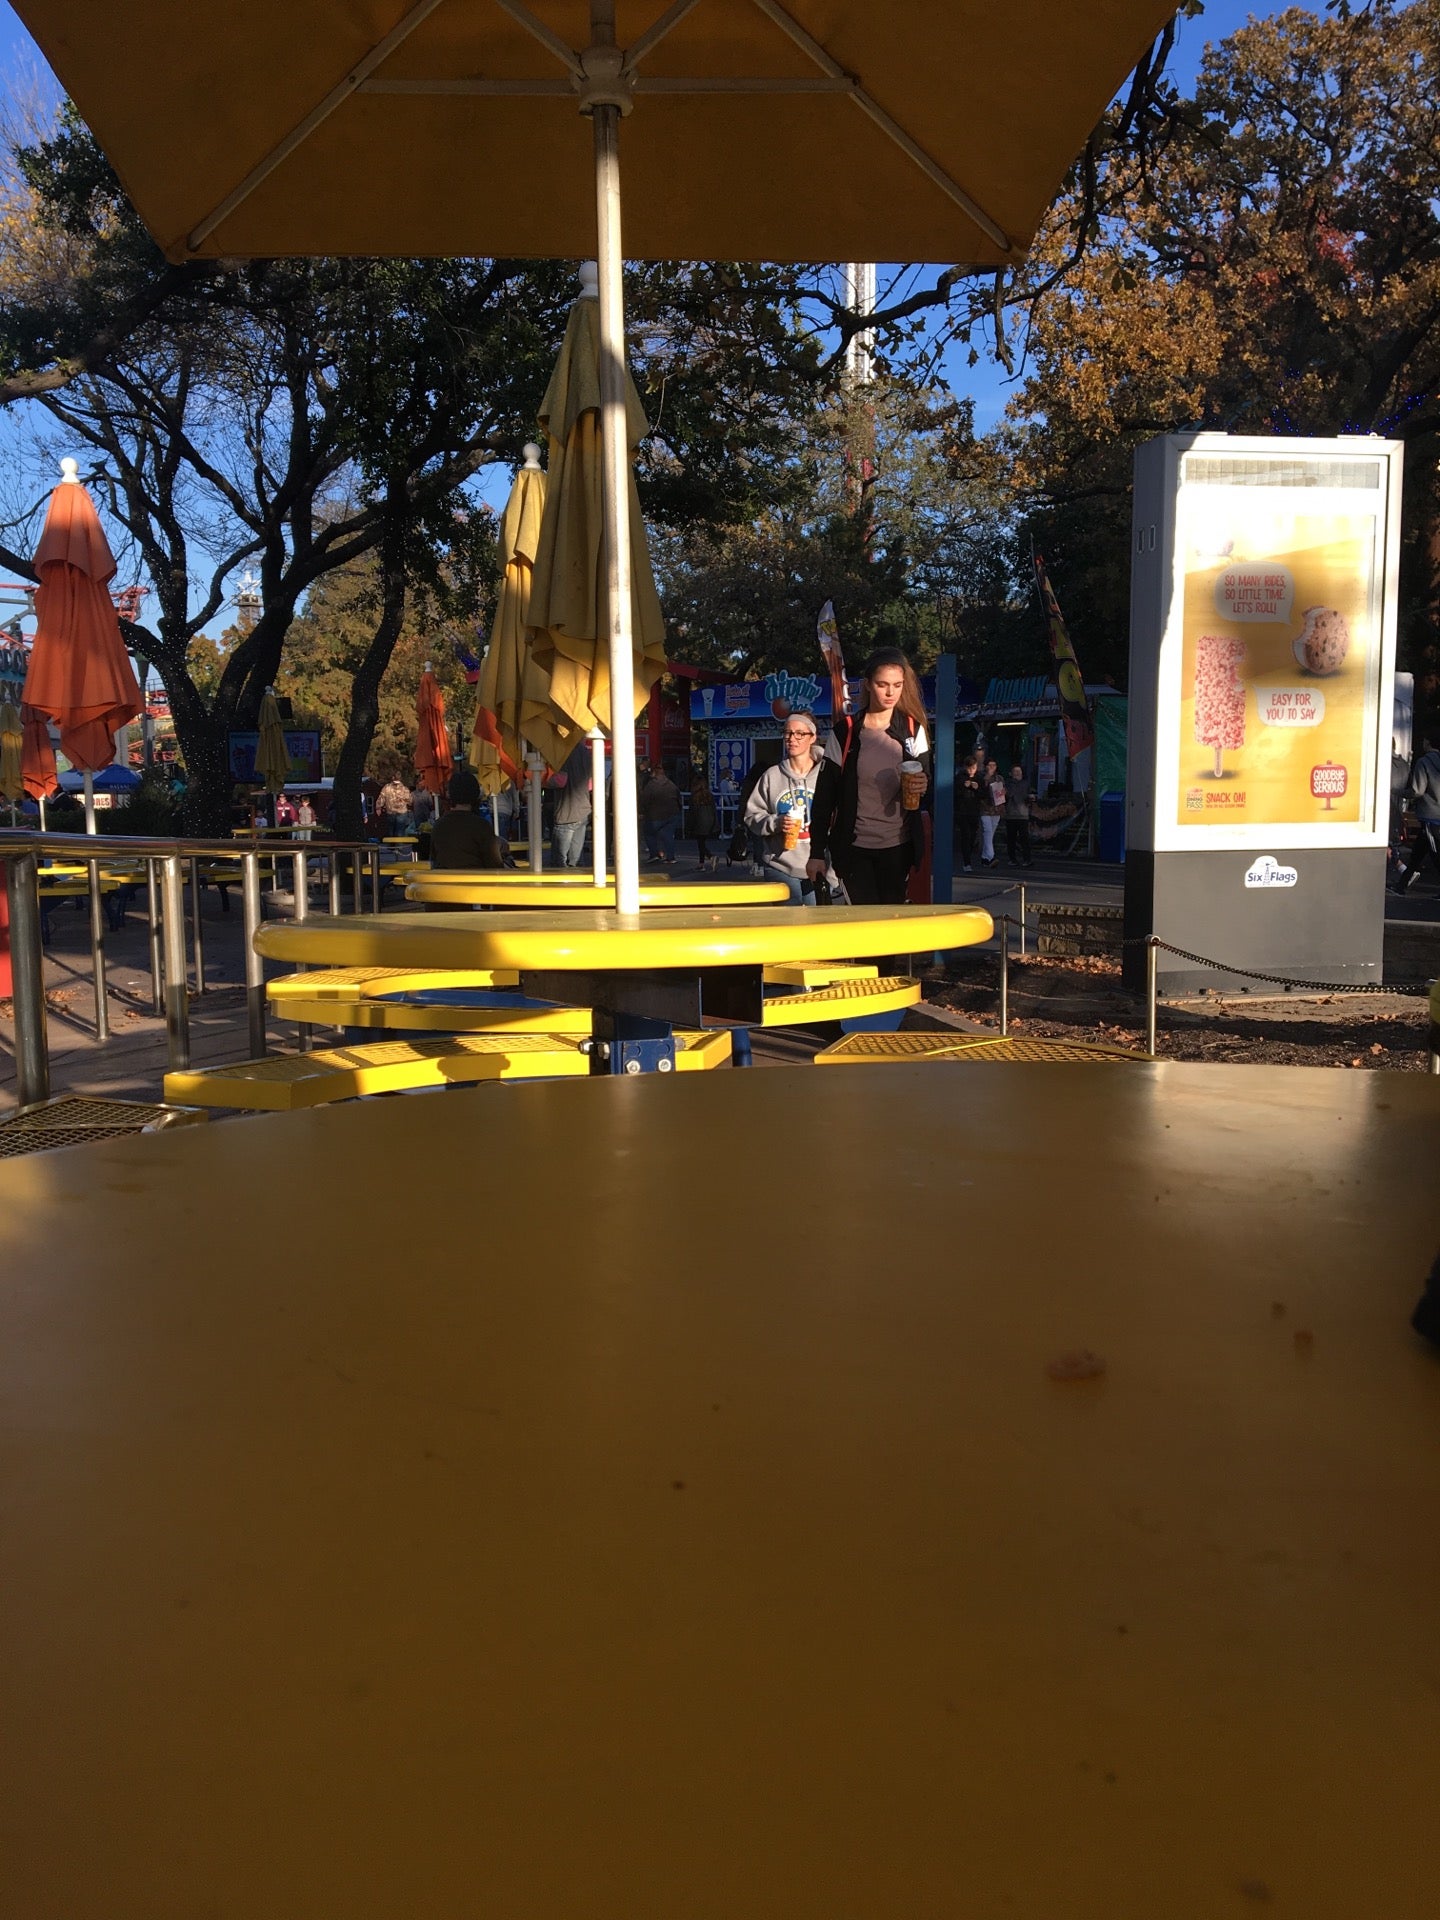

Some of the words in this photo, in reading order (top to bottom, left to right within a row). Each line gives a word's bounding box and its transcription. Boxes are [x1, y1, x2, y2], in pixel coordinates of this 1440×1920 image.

[1225, 575, 1235, 586] SO
[1238, 575, 1261, 586] MANY
[1264, 575, 1286, 588] RIDES,
[1225, 588, 1235, 600] SO
[1238, 588, 1261, 600] LITTLE
[1265, 588, 1285, 600] TIME.
[1232, 602, 1252, 613] LET'S
[1255, 602, 1277, 615] ROLL!
[1271, 693, 1292, 706] EASY
[1295, 693, 1311, 706] FOR
[1266, 708, 1284, 720] YOU
[1288, 708, 1297, 720] TO
[1300, 708, 1316, 720] SAY
[1206, 792, 1231, 803] SNACK
[1233, 792, 1246, 803] ON!
[1247, 872, 1262, 882] Six
[1270, 872, 1296, 883] Flags
